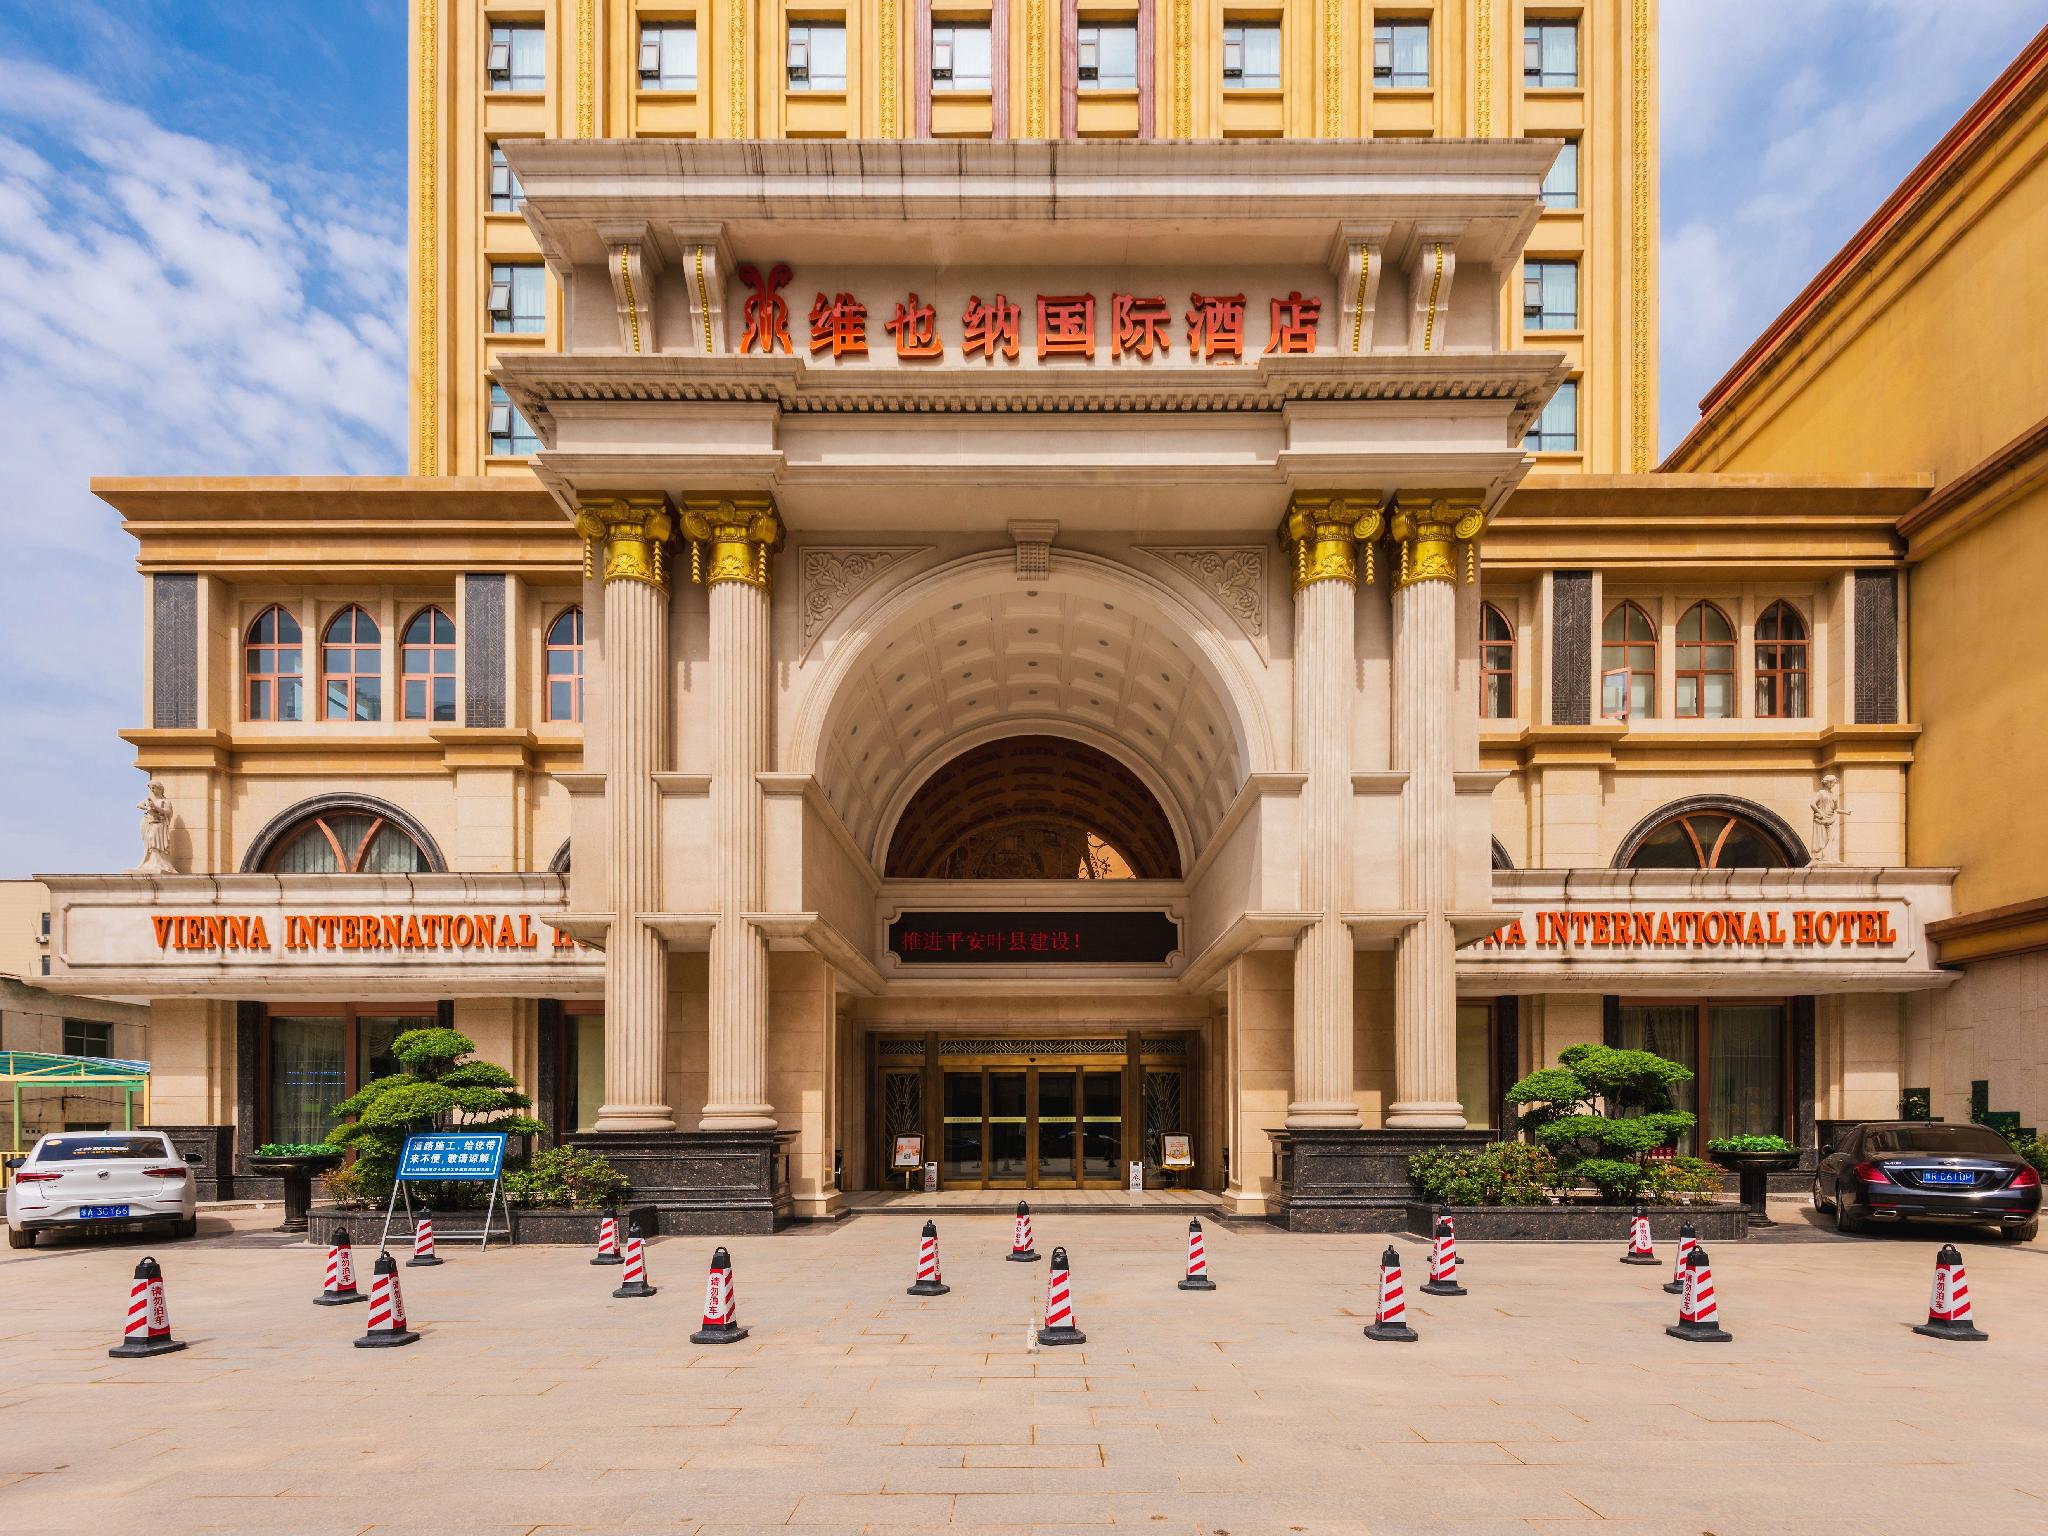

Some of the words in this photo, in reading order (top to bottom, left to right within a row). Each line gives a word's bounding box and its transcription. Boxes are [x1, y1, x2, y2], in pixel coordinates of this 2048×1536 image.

[808, 291, 1322, 360] 维也纳国际酒店
[151, 915, 272, 950] VIENNA
[284, 914, 538, 949] INTERNATIONAL
[1535, 911, 1786, 945] INTERNATIONAL
[1792, 910, 1897, 945] HOTEL
[341, 1251, 351, 1282] 请勿泊车
[152, 1286, 165, 1325] 请勿泊车
[709, 1276, 720, 1315] 请勿泊车
[1683, 1273, 1692, 1311] 请勿泊车
[1935, 1272, 1946, 1310] 请勿泊车
